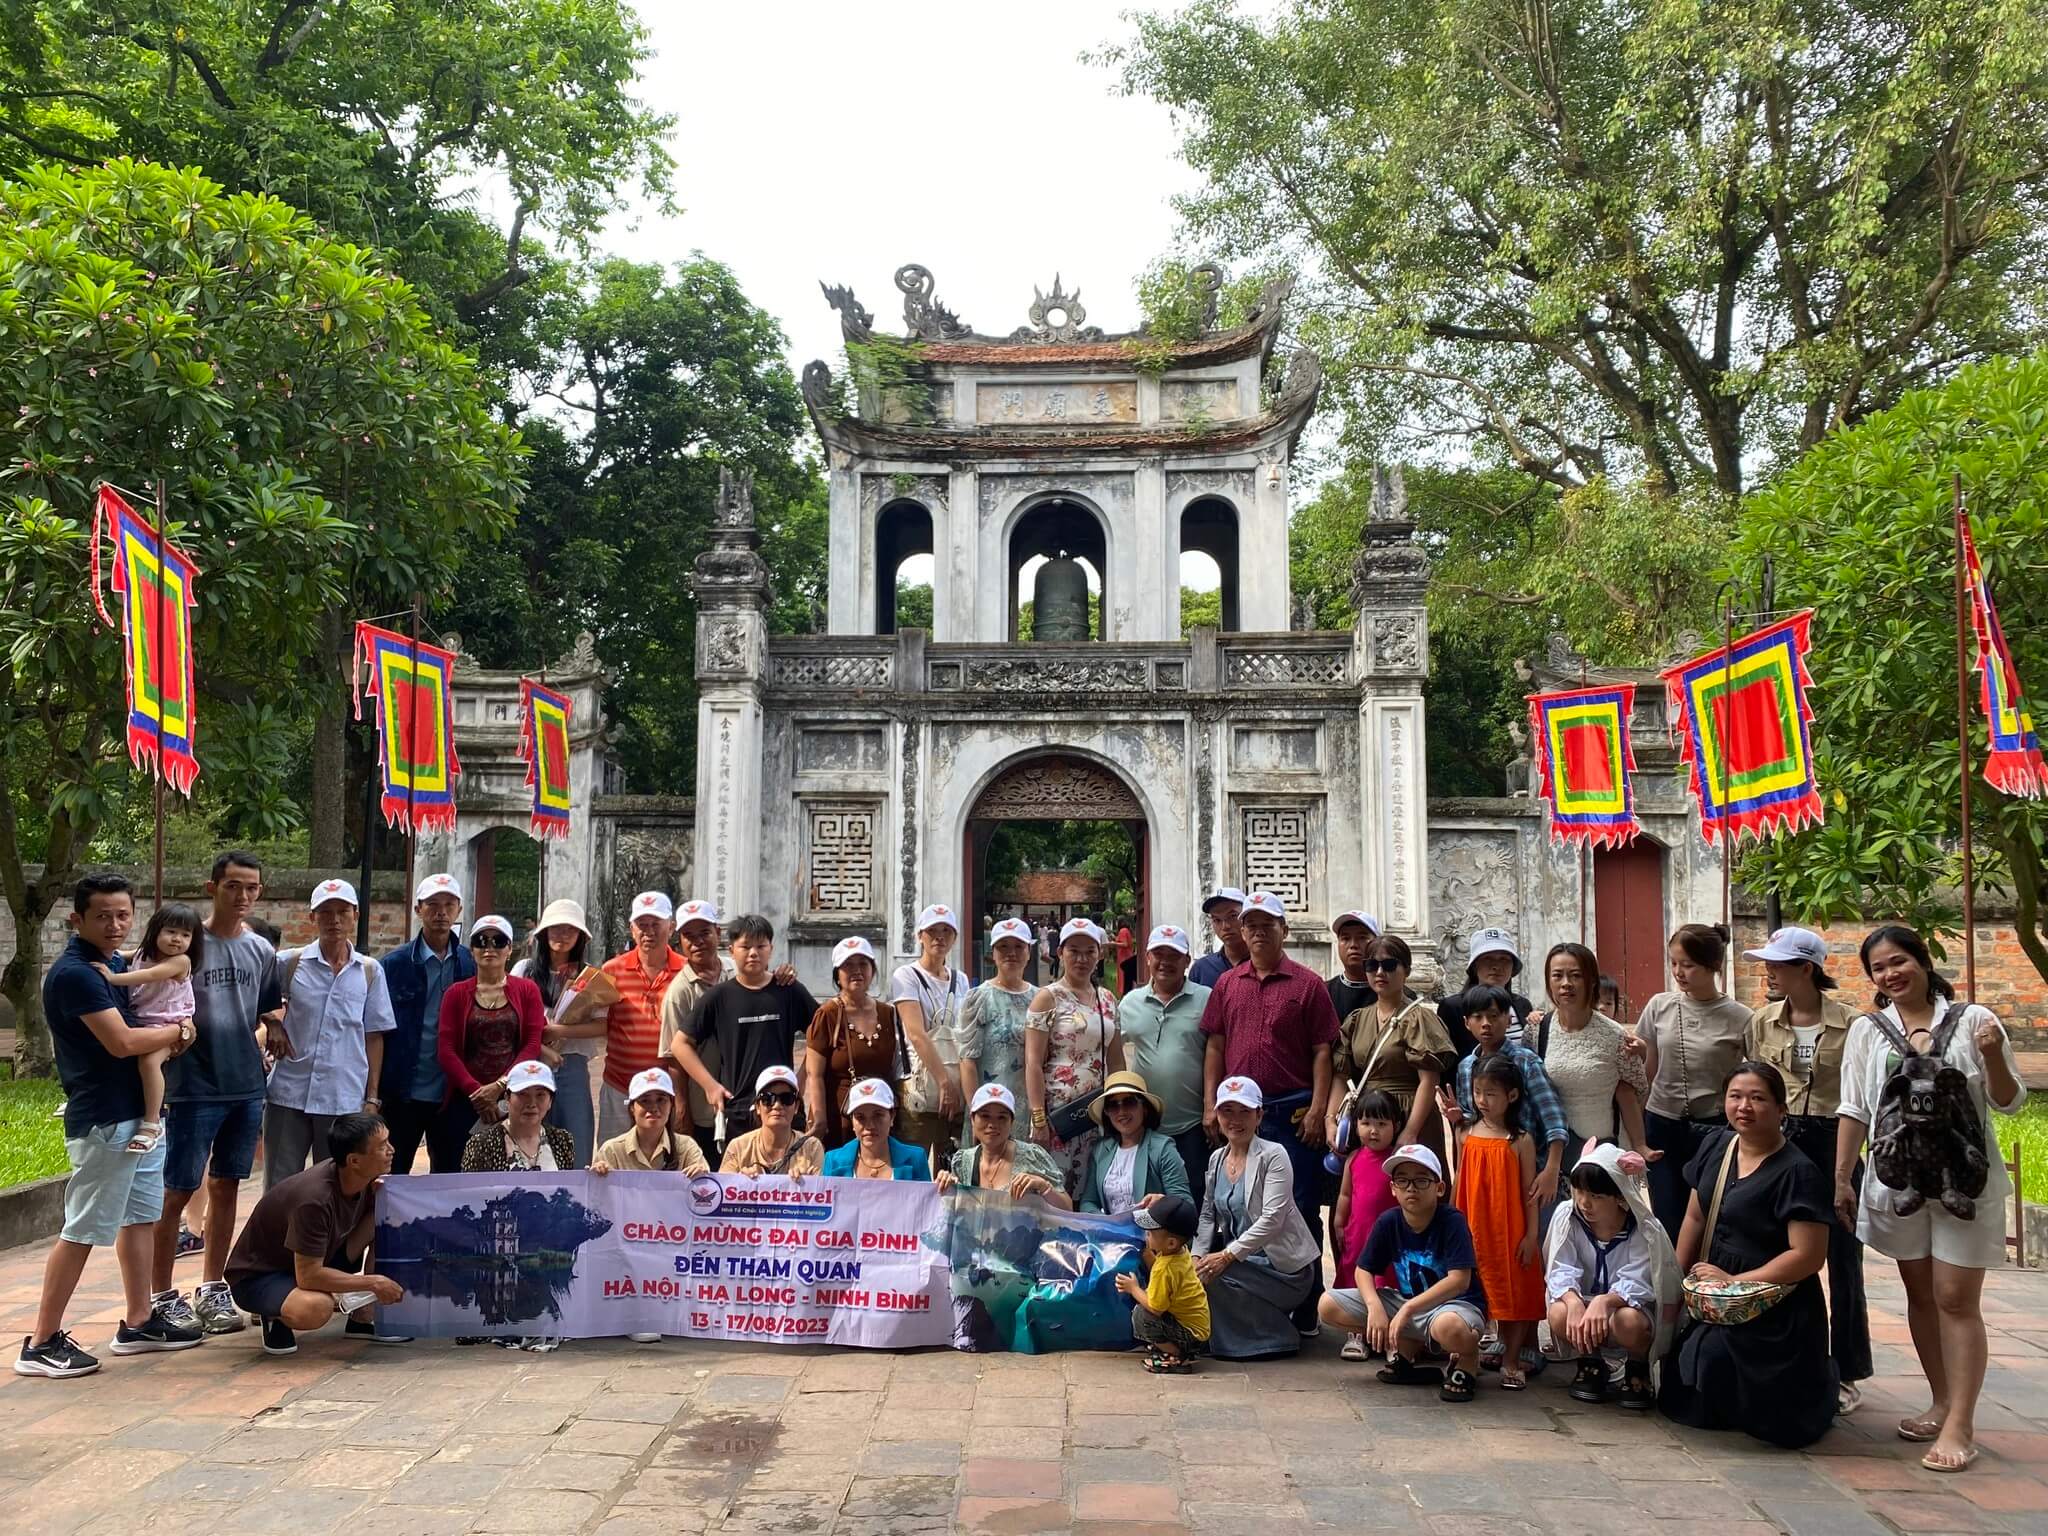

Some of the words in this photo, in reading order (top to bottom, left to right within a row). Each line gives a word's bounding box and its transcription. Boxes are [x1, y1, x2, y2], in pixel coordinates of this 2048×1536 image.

[725, 1186, 833, 1204] Sacotravel
[623, 1219, 686, 1242] CHÀO
[692, 1219, 763, 1246] MỪNG
[768, 1228, 809, 1251] ĐẠI
[815, 1230, 855, 1248] GIA
[860, 1228, 919, 1251] ĐÌNH
[674, 1250, 721, 1275] ĐẾN
[726, 1257, 791, 1278] THAM
[797, 1260, 862, 1283] QUAN
[603, 1276, 636, 1297] HÀ
[643, 1277, 681, 1300] NỘI
[698, 1286, 731, 1306] HẠ
[736, 1287, 796, 1306] LONG
[815, 1290, 870, 1308] NINH
[876, 1287, 931, 1310] BÌNH
[690, 1313, 710, 1329] 13
[726, 1314, 829, 1336] 17/08/2023
